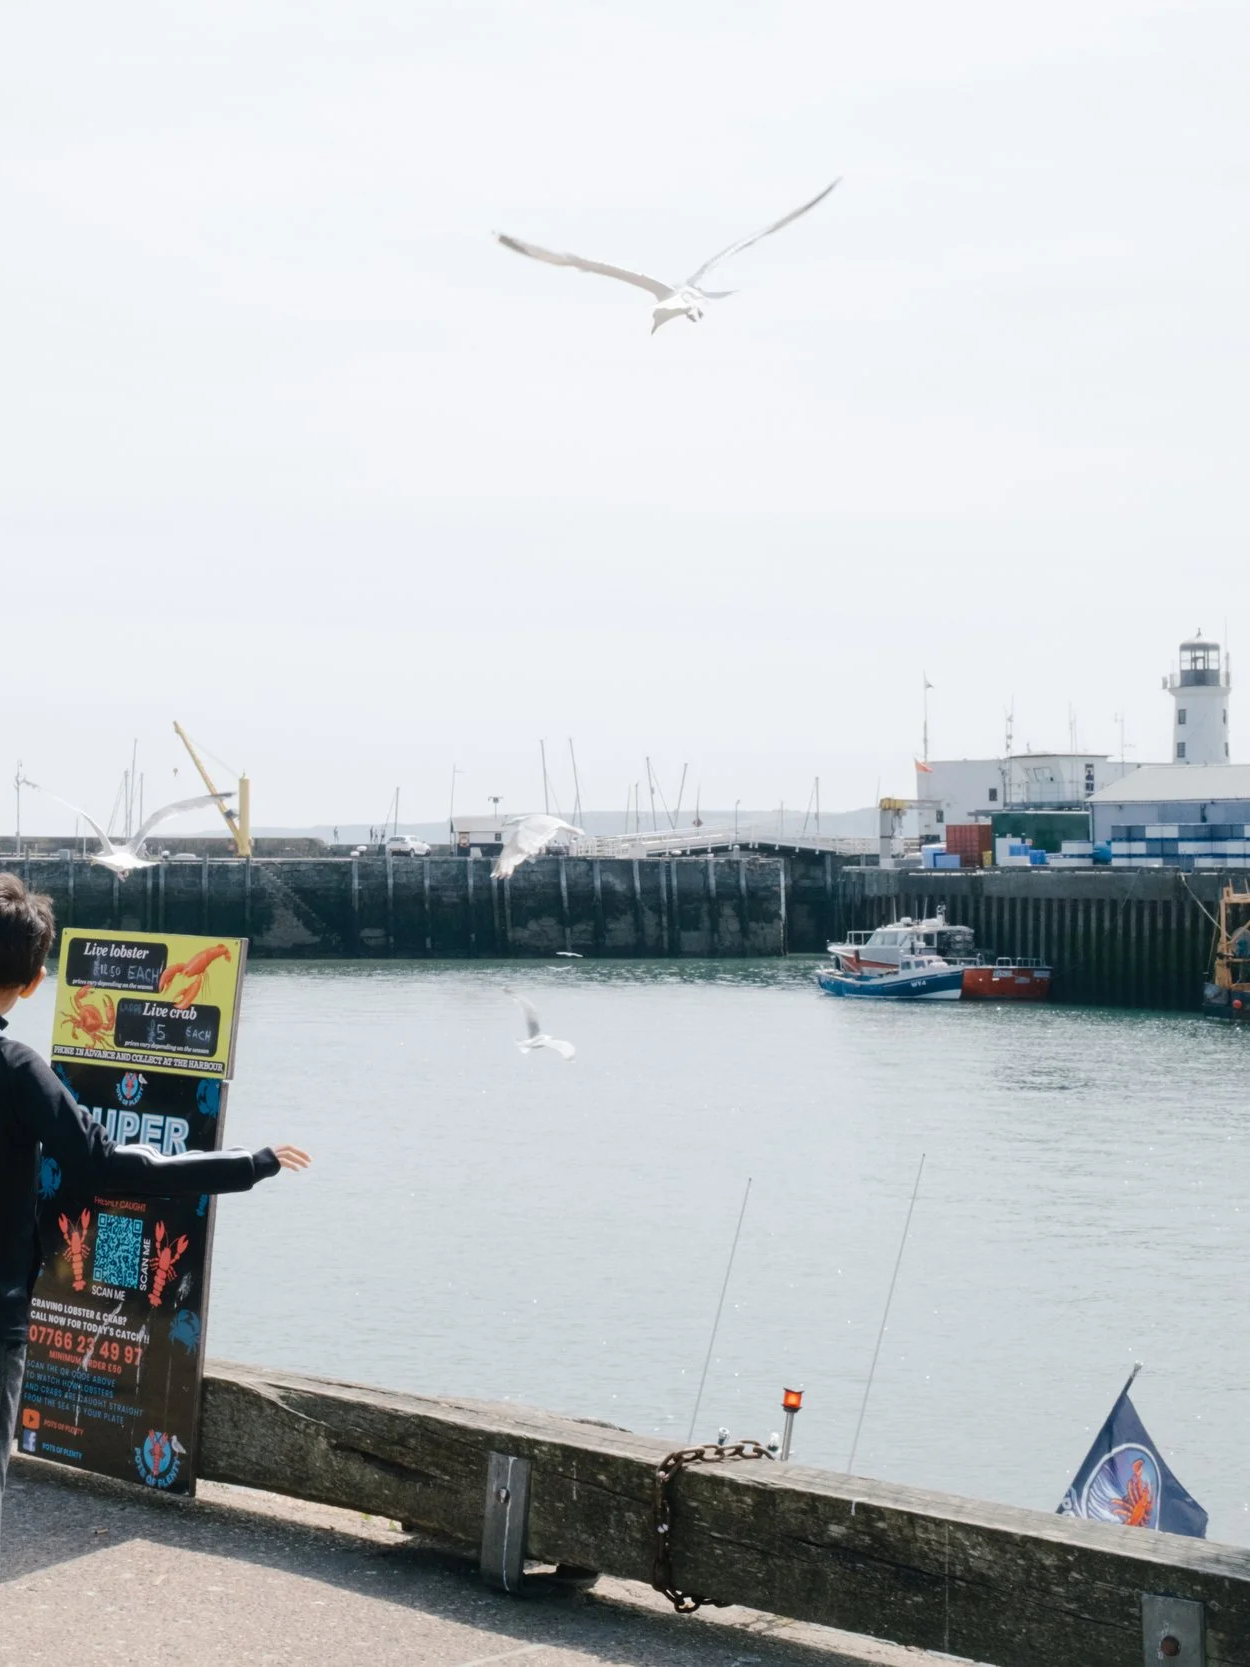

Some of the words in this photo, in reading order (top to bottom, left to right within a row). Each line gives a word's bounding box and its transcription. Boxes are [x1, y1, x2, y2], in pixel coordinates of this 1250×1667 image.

[83, 942, 108, 957] Live
[109, 944, 149, 959] lobster
[128, 965, 160, 982] EACH
[142, 1002, 168, 1017] Live
[169, 1006, 197, 1020] crab
[185, 1026, 212, 1042] EACH
[54, 1045, 74, 1055] PHONE
[75, 1048, 84, 1056] IN
[84, 1049, 115, 1060] ADVANCE
[116, 1052, 131, 1061] AND
[131, 1054, 163, 1065] COLLECT
[163, 1057, 173, 1065] AT
[173, 1059, 188, 1067] THE
[188, 1060, 224, 1072] HARBOUR
[119, 1200, 147, 1212] CAUGHT
[142, 1238, 151, 1257] ME
[139, 1257, 149, 1291] SCAN
[91, 1285, 114, 1299] SCAN
[113, 1290, 126, 1301] ME
[30, 1310, 47, 1322] CALL
[48, 1314, 66, 1326] NOW
[67, 1318, 82, 1330] FOR
[82, 1321, 115, 1337] TODAY'S
[31, 1298, 64, 1312] CRAVING
[63, 1303, 96, 1320] LOBSTER
[95, 1312, 101, 1320] &
[102, 1313, 127, 1326] CRAB?
[29, 1324, 73, 1350] 07766
[76, 1335, 96, 1354] 23
[99, 1341, 120, 1361] 49
[124, 1345, 143, 1366] 97
[26, 1360, 45, 1370] SCAN
[46, 1363, 59, 1373] THE
[92, 1375, 117, 1388] ABOVE
[49, 1350, 82, 1366] MINIMUM
[107, 1362, 122, 1375] £50
[26, 1370, 35, 1379] TO
[36, 1373, 61, 1385] WATCH
[61, 1379, 79, 1390] HOW
[80, 1384, 114, 1399] LOBSTERS
[23, 1391, 42, 1403] FROM
[44, 1397, 56, 1407] THE
[57, 1401, 70, 1411] SEA
[72, 1404, 81, 1413] TO
[83, 1408, 102, 1419] YOUR
[103, 1412, 124, 1425] PLATE
[24, 1382, 39, 1392] AND
[40, 1385, 63, 1398] CRABS
[63, 1390, 77, 1401] ARE
[78, 1394, 107, 1407] CAUGHT
[109, 1402, 144, 1417] STRAIGHT
[44, 1418, 58, 1429] POTS
[41, 1442, 56, 1452] POTS
[134, 1447, 147, 1478] POTS
[145, 1474, 156, 1486] OF
[157, 1456, 182, 1488] PLENTY
